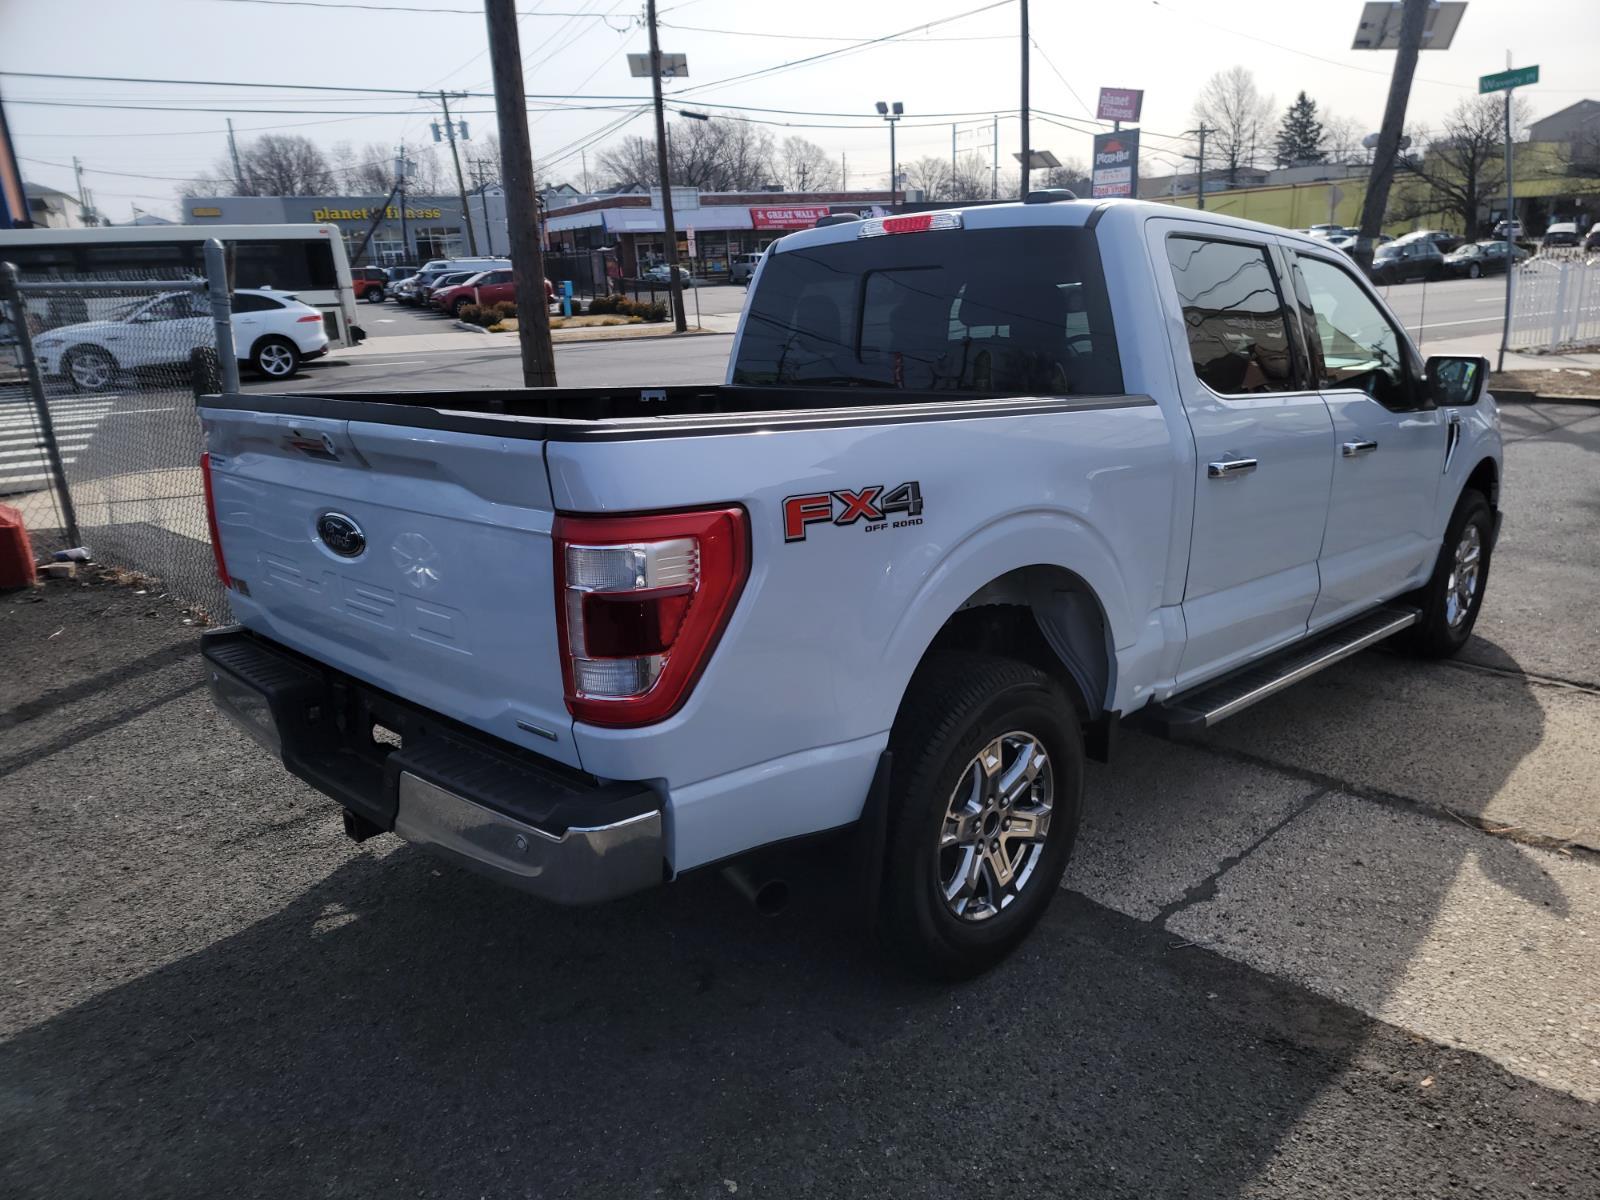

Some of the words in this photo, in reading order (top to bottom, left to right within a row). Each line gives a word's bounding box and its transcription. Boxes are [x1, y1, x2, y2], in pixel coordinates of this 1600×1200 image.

[313, 206, 368, 222] planet
[386, 205, 442, 219] finess
[767, 211, 792, 219] GREAT
[793, 210, 816, 218] WALL
[781, 481, 923, 543] FX4
[865, 523, 889, 533] OFF
[892, 518, 923, 529] ROAD
